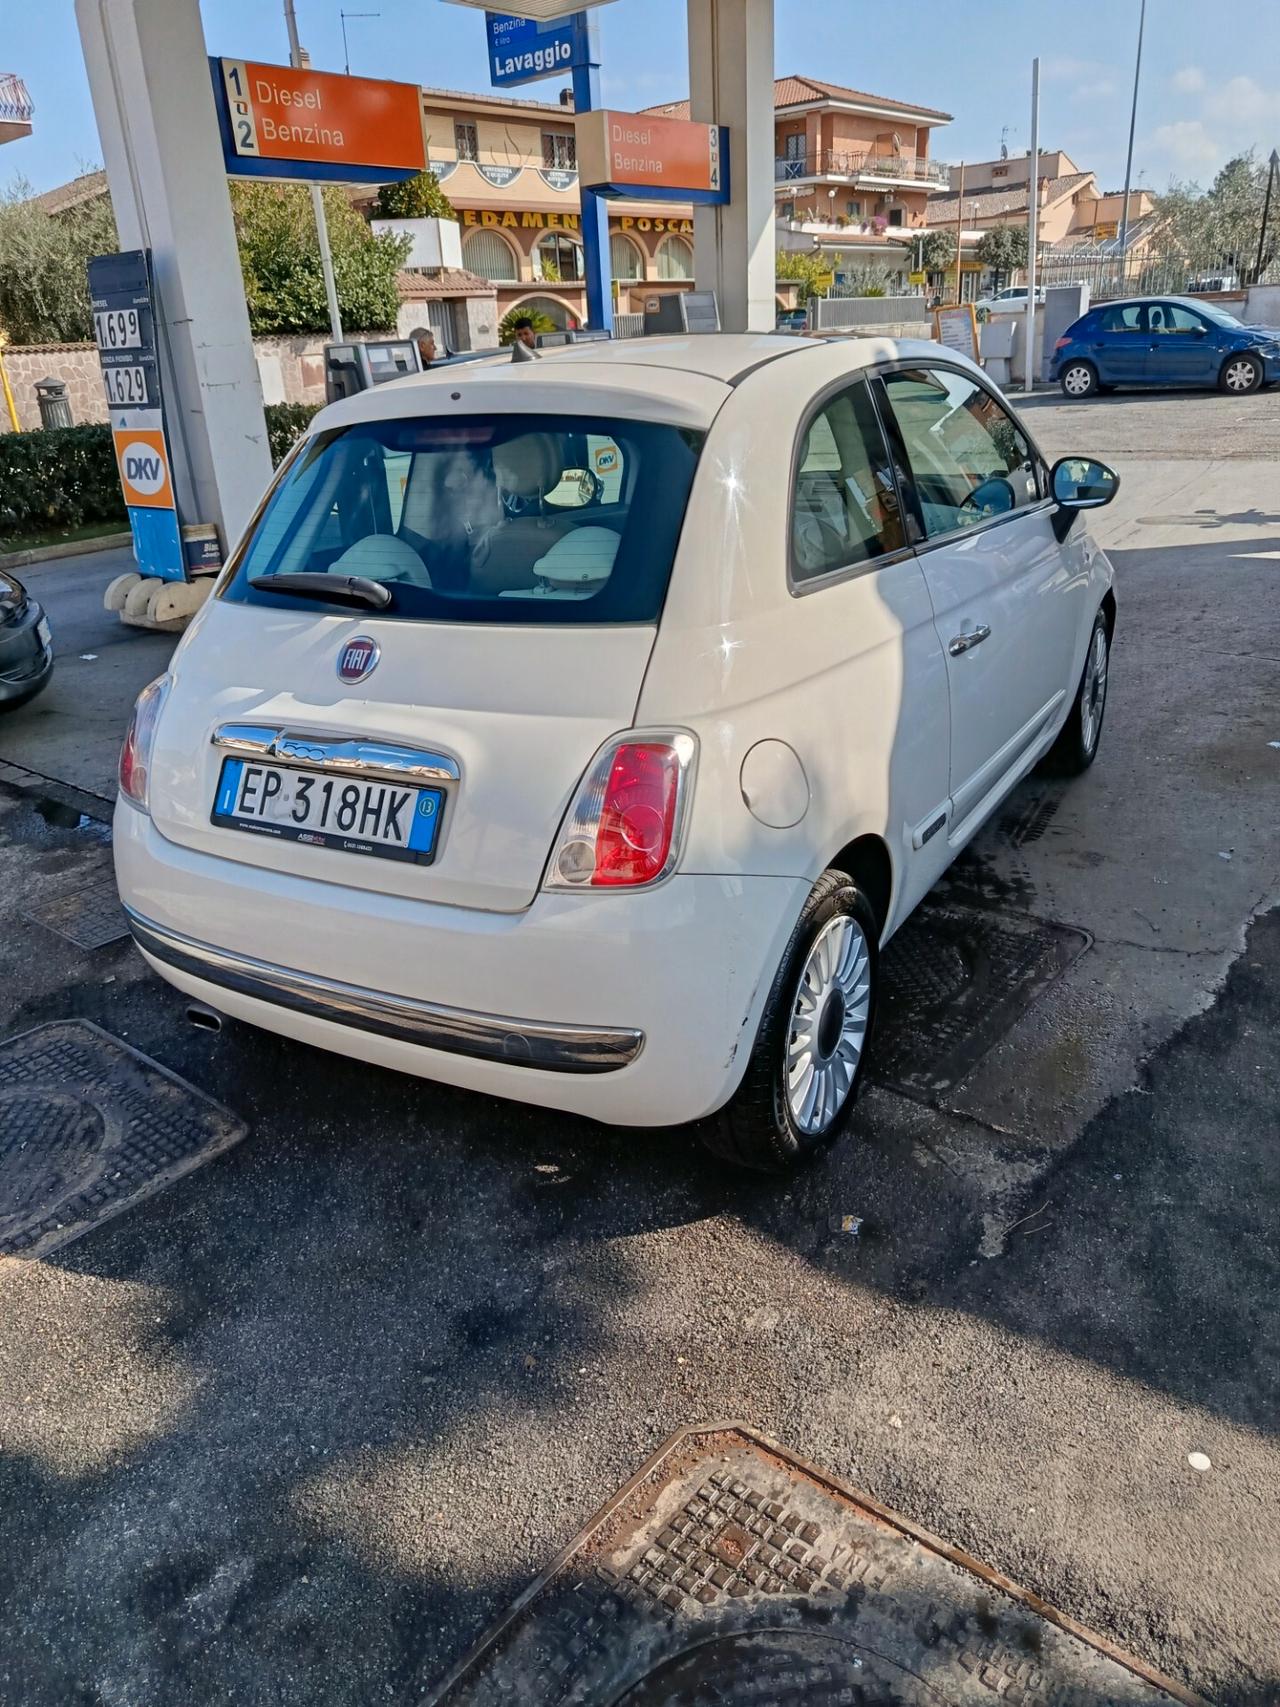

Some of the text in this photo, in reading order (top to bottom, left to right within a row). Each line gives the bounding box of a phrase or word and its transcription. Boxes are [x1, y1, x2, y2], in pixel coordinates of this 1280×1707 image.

[493, 18, 526, 35] Benzina
[495, 40, 571, 77] Lavaggio
[229, 67, 242, 97] 1
[256, 80, 322, 110] Diesel
[237, 120, 254, 149] 2
[262, 117, 345, 147] Benzina
[612, 124, 651, 145] Diesel
[710, 128, 718, 148] 3
[614, 152, 663, 174] Benzina
[710, 167, 718, 187] 4
[126, 457, 160, 480] DKV
[343, 648, 370, 671] FIAT
[283, 742, 326, 761] 500
[238, 767, 282, 816] EP
[291, 776, 411, 841] 318HK
